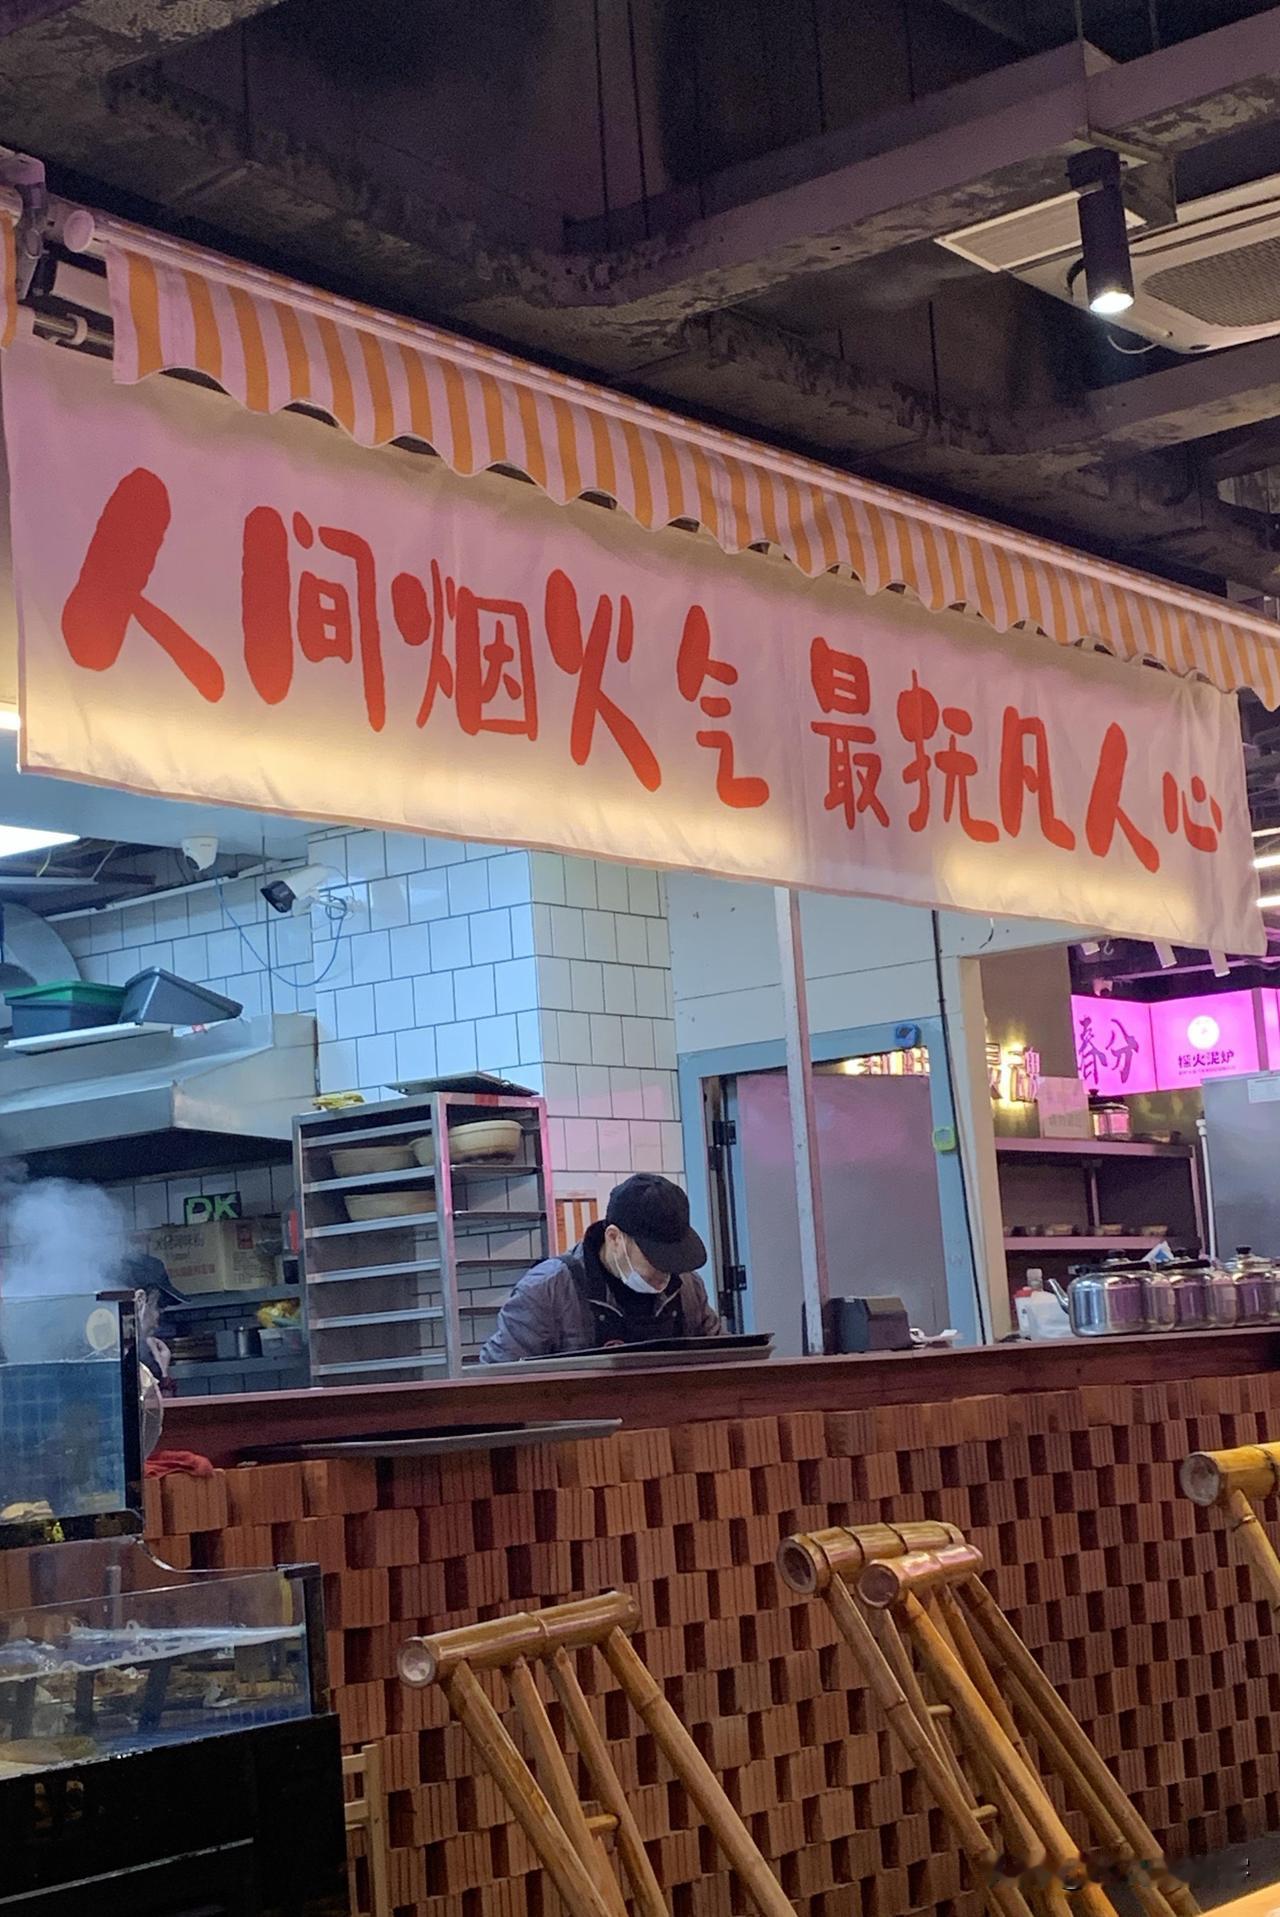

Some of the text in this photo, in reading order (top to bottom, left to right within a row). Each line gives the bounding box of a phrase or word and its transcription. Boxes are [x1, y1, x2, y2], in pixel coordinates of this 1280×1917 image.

[61, 467, 1223, 873] 人间烟火气 最抚凡人心
[1078, 1016, 1139, 1085] 春分
